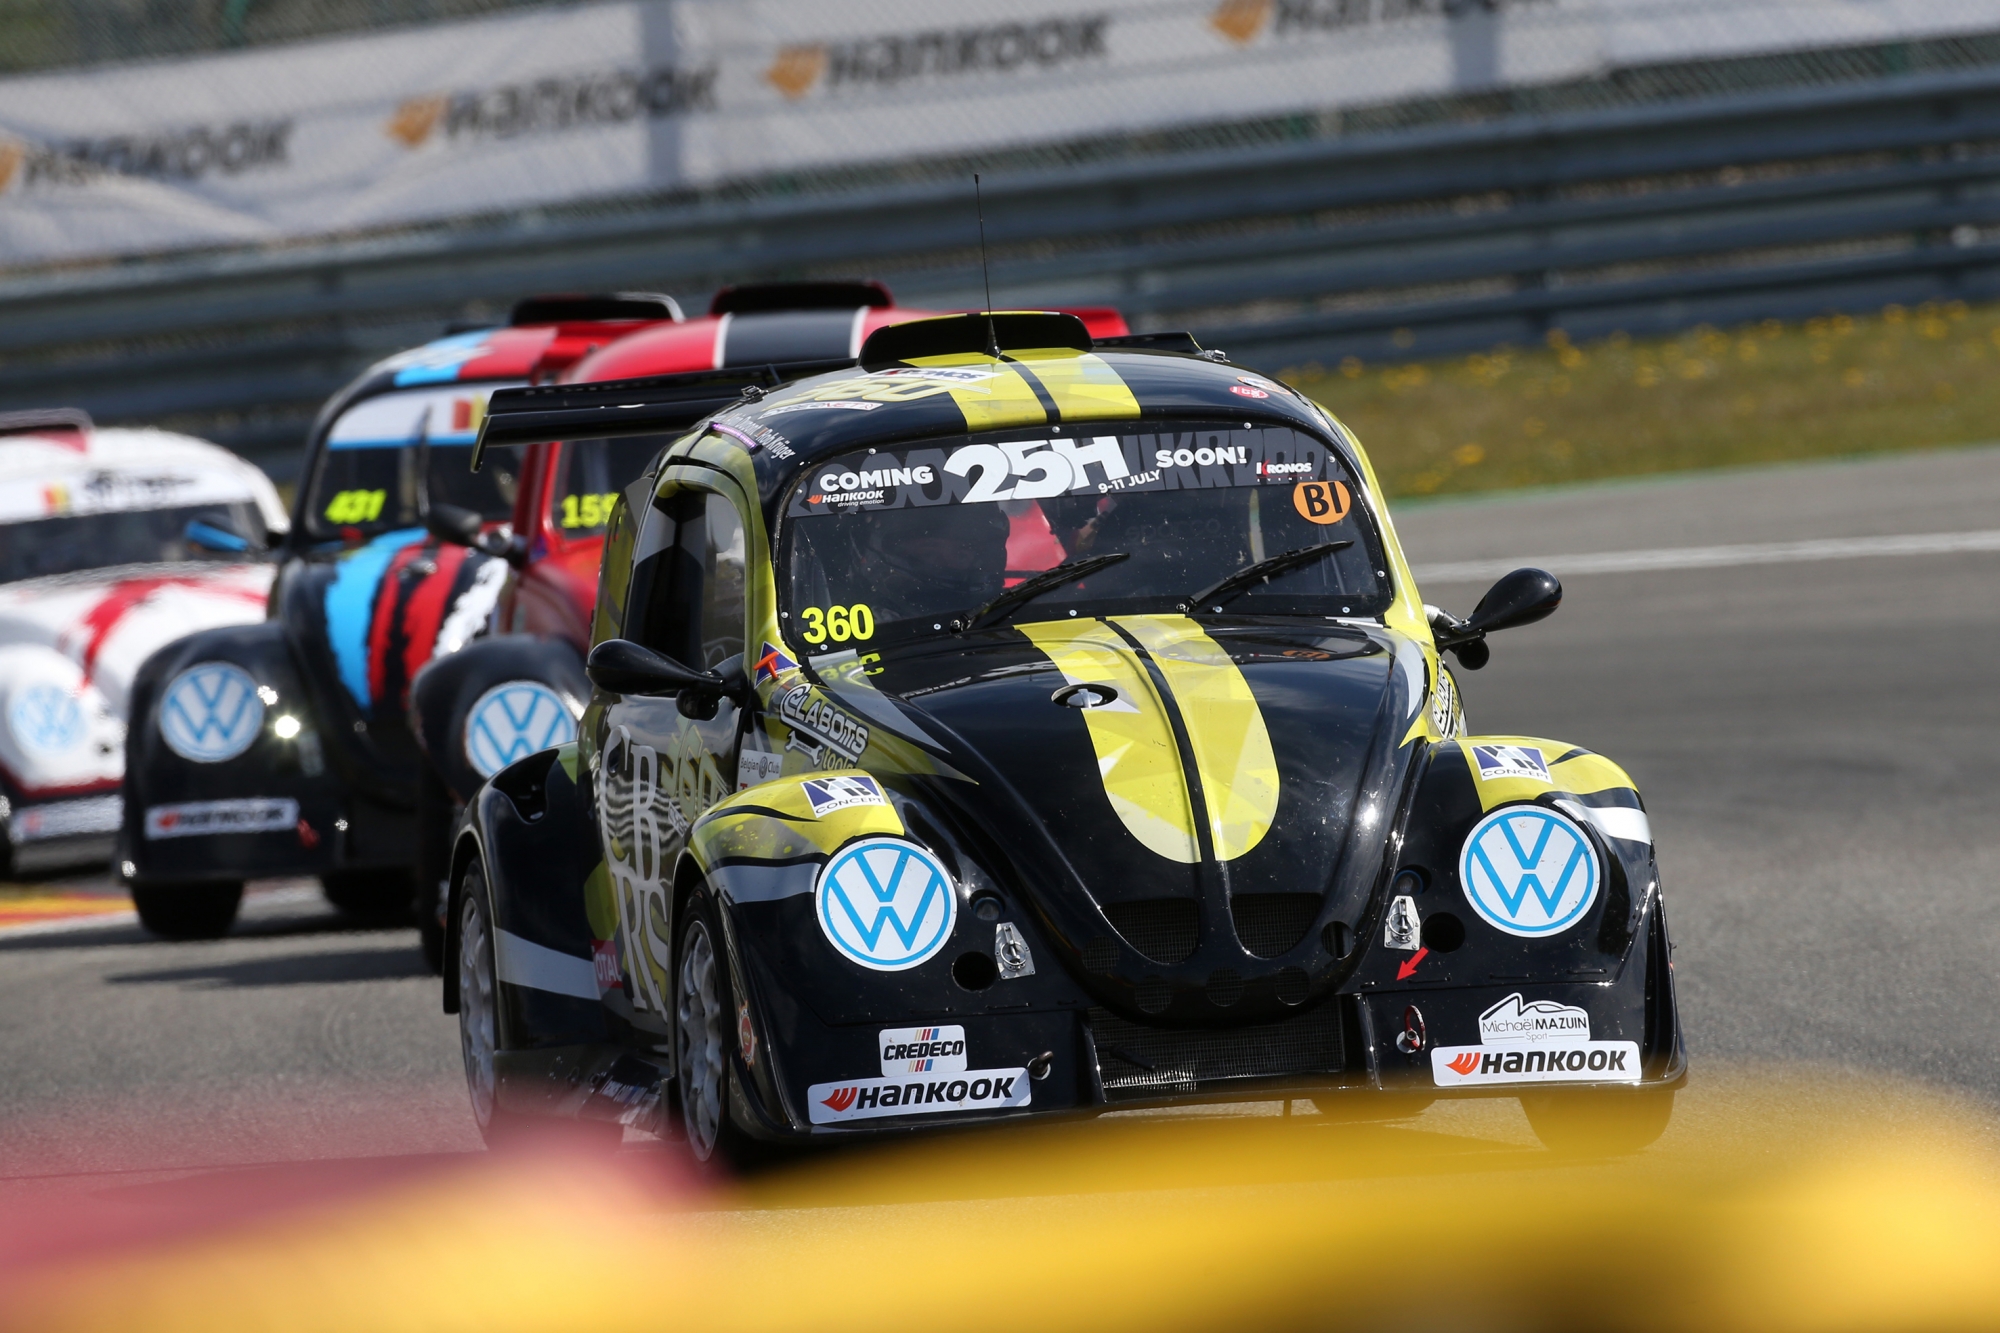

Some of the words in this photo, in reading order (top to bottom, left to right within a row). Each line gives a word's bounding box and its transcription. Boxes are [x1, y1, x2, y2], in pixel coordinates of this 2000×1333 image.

[820, 466, 934, 492] COMING
[1155, 446, 1248, 468] SOON!
[943, 436, 1131, 504] 25H
[1098, 479, 1126, 494] 9-11
[1128, 469, 1161, 488] JULY
[801, 603, 875, 644] 360
[1482, 769, 1549, 780] CONCEPT
[814, 797, 883, 814] CONCEPT
[1482, 1019, 1535, 1033] Michaël
[1535, 1017, 1587, 1030] MAZUIN
[1526, 1032, 1548, 1042] Sport
[883, 1040, 965, 1060] CREDECO
[1480, 1049, 1627, 1075] HANKOOK
[856, 1077, 1016, 1110] HANKOOK
